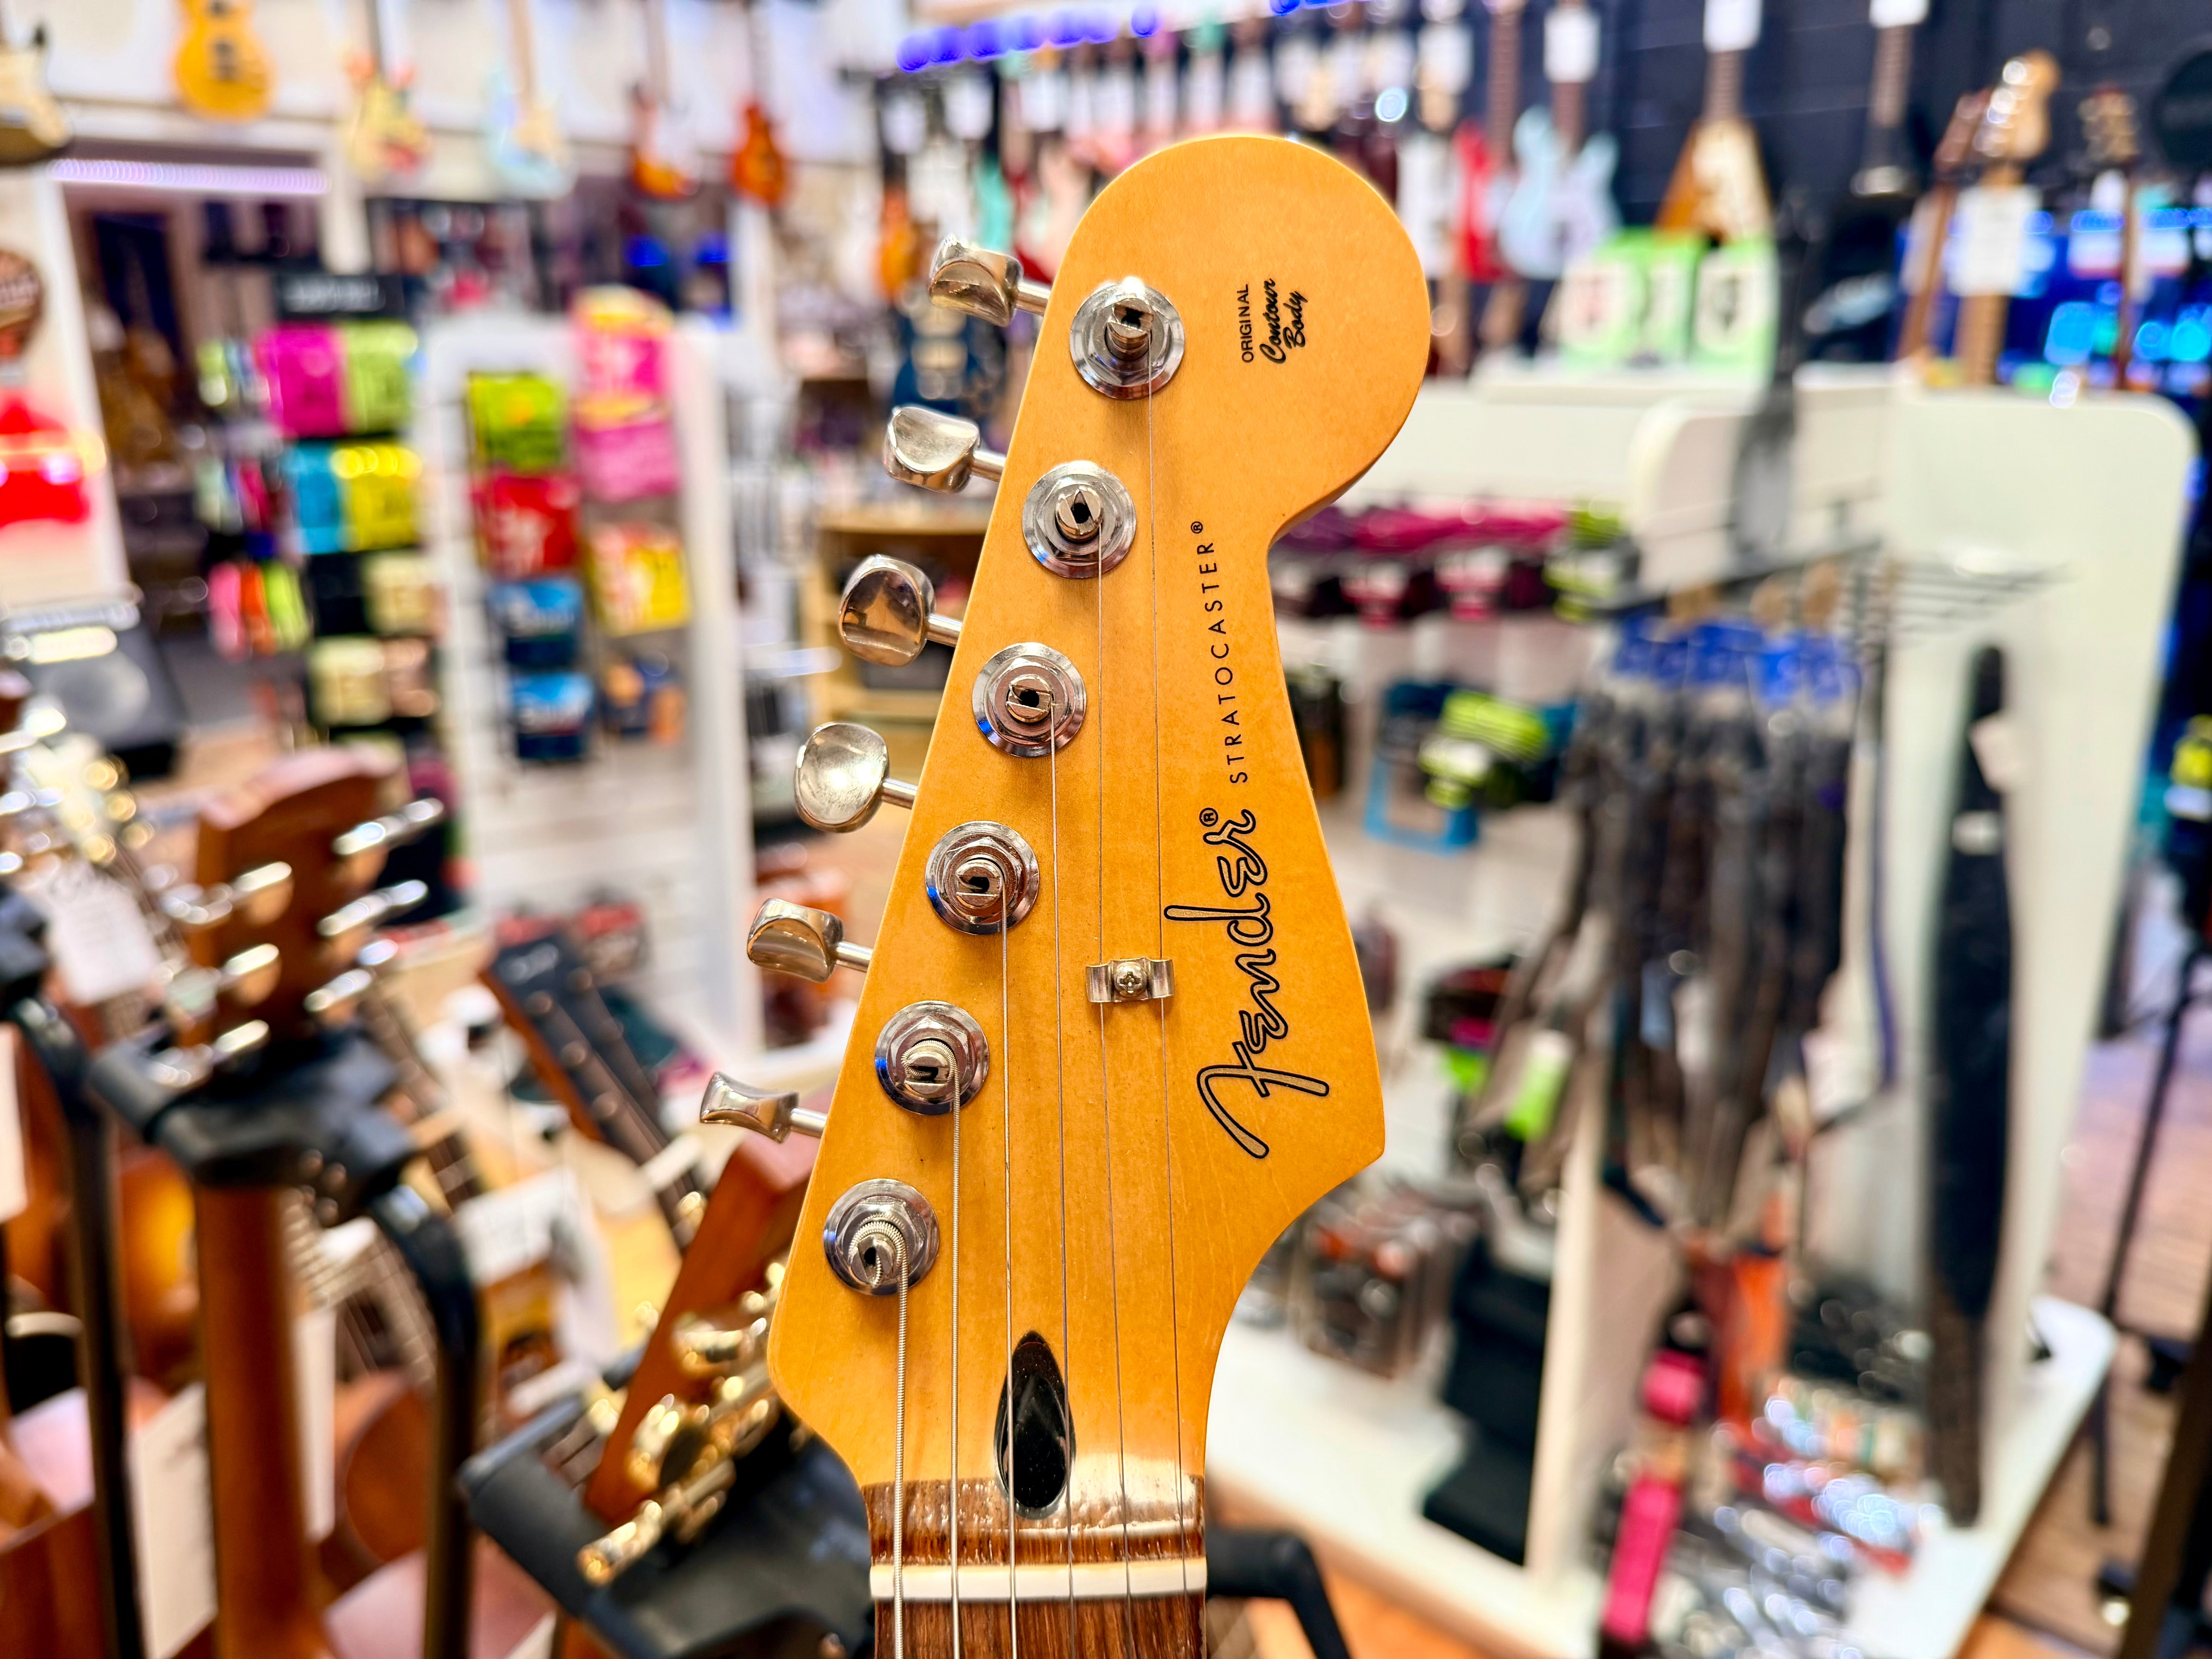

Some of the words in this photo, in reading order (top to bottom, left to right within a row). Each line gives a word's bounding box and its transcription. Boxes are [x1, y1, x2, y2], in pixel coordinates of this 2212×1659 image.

[1237, 284, 1254, 363] ORIGINAL
[1259, 278, 1286, 364] Contour
[1283, 290, 1309, 349] Body
